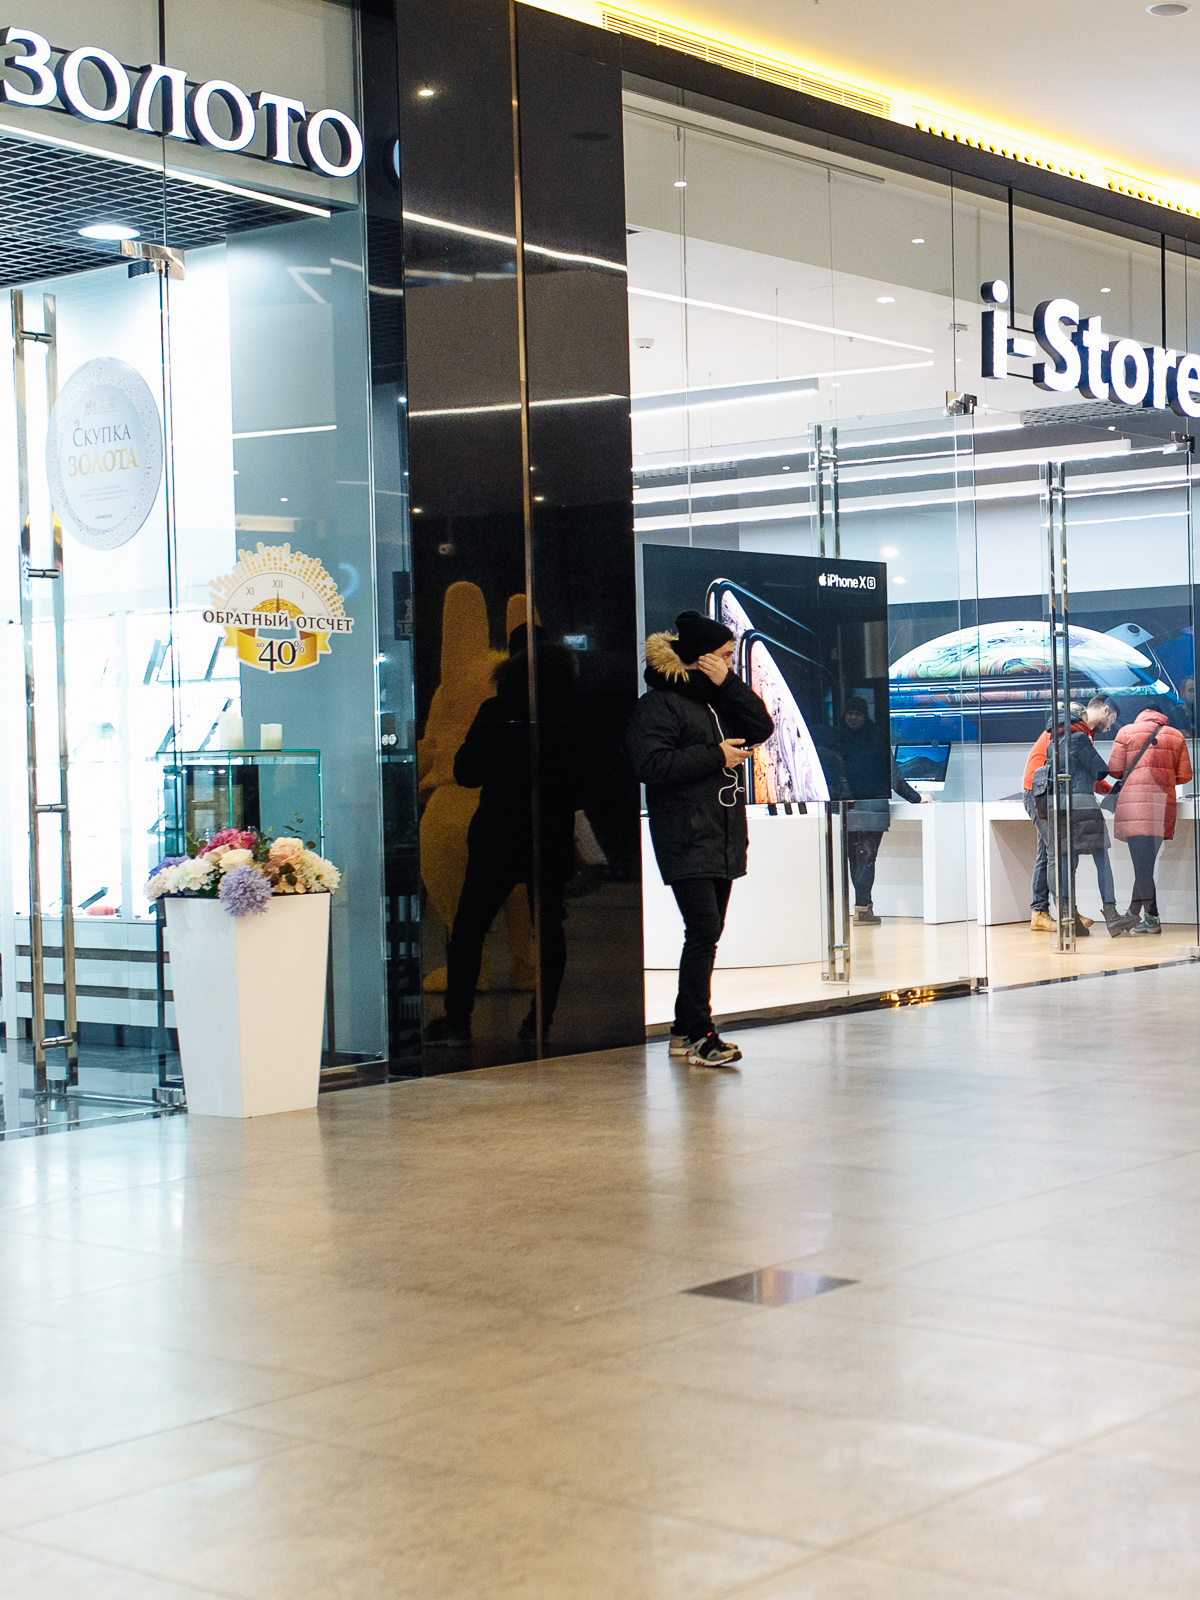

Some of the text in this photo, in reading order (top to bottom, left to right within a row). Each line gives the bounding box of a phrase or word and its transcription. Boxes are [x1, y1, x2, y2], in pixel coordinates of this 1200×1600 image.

[1, 26, 364, 178] ЗОЛОТО
[68, 447, 139, 477] ЗОЛОТА
[827, 574, 859, 589] iPhone
[203, 609, 353, 631] ОБРАТНЫЙ ОТСЧЕТ
